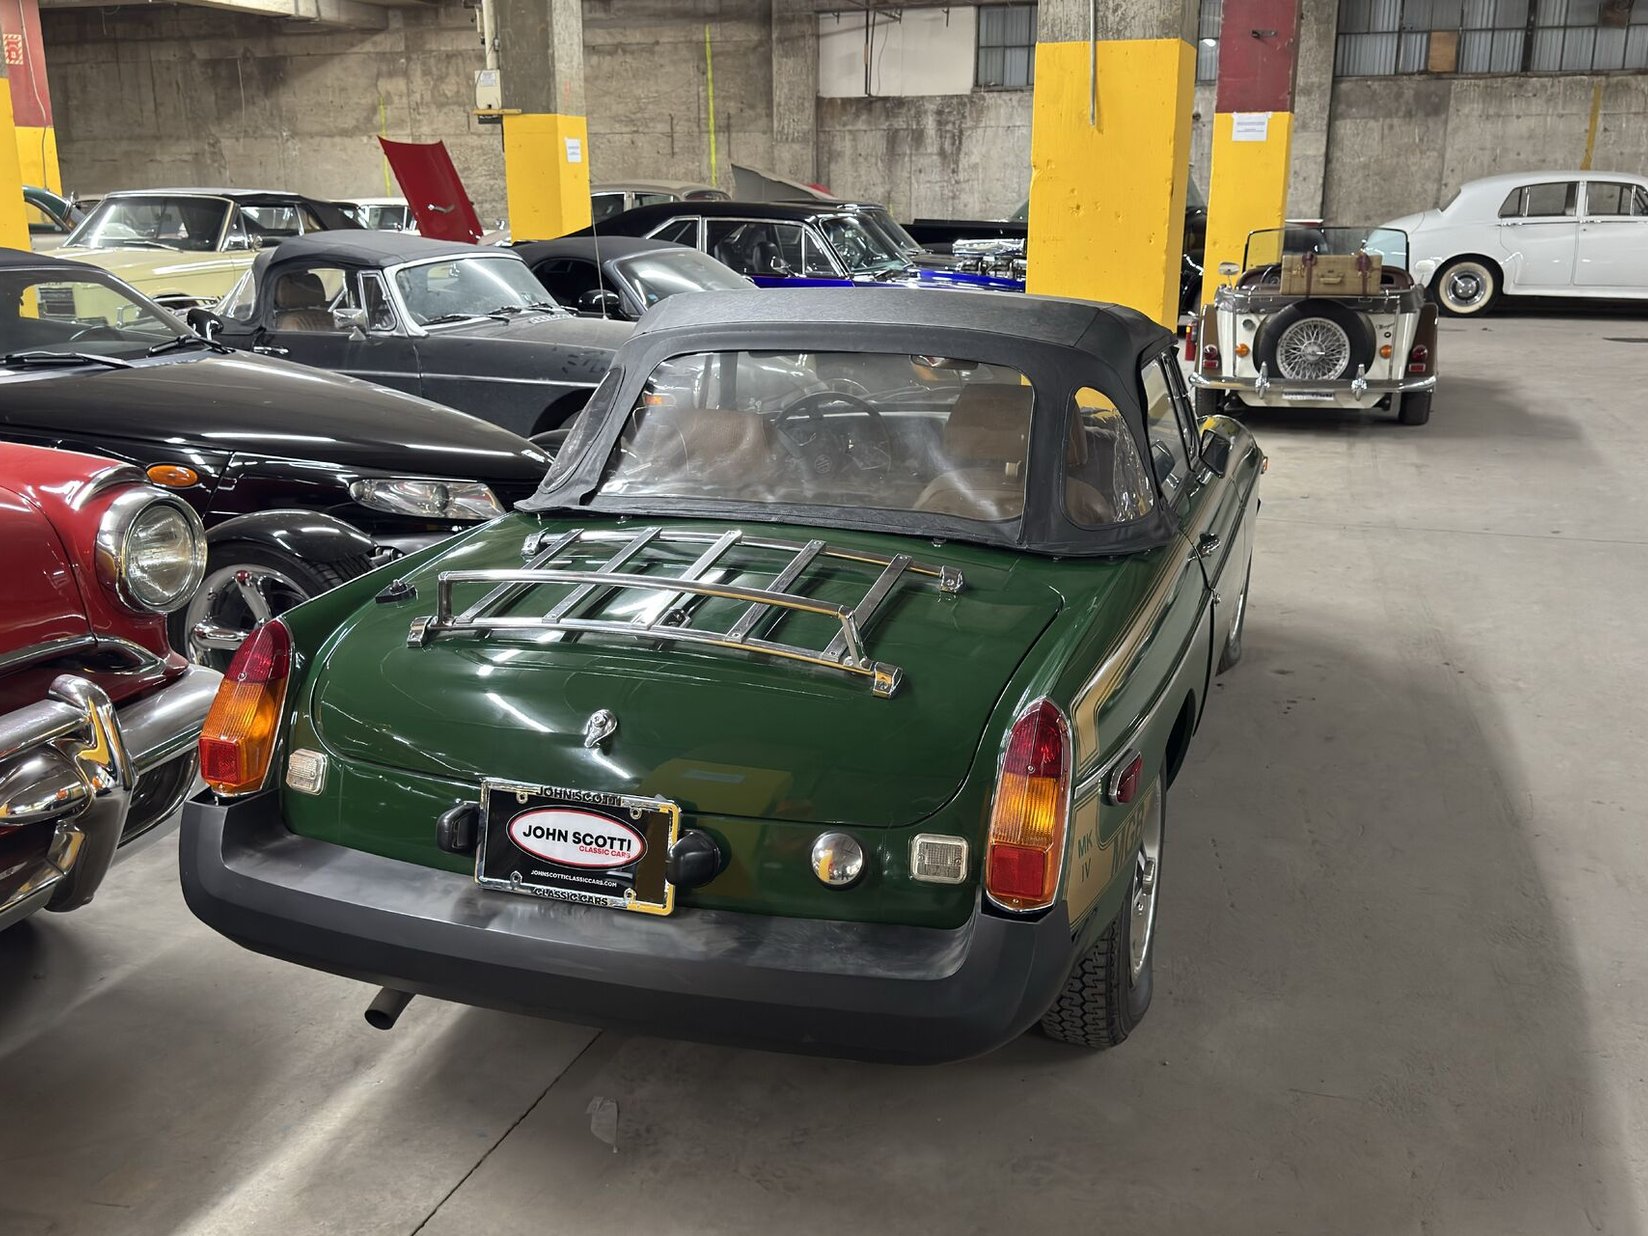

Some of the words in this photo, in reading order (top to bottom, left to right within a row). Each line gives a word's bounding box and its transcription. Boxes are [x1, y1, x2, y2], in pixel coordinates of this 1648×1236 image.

[523, 825, 568, 843] JOHN
[573, 831, 631, 852] SCOTTI
[1078, 830, 1093, 859] MK
[579, 845, 610, 856] CLASSIC
[611, 850, 631, 859] CARS
[531, 869, 617, 888] JOHNSCOTTICLASSICCARS.COM
